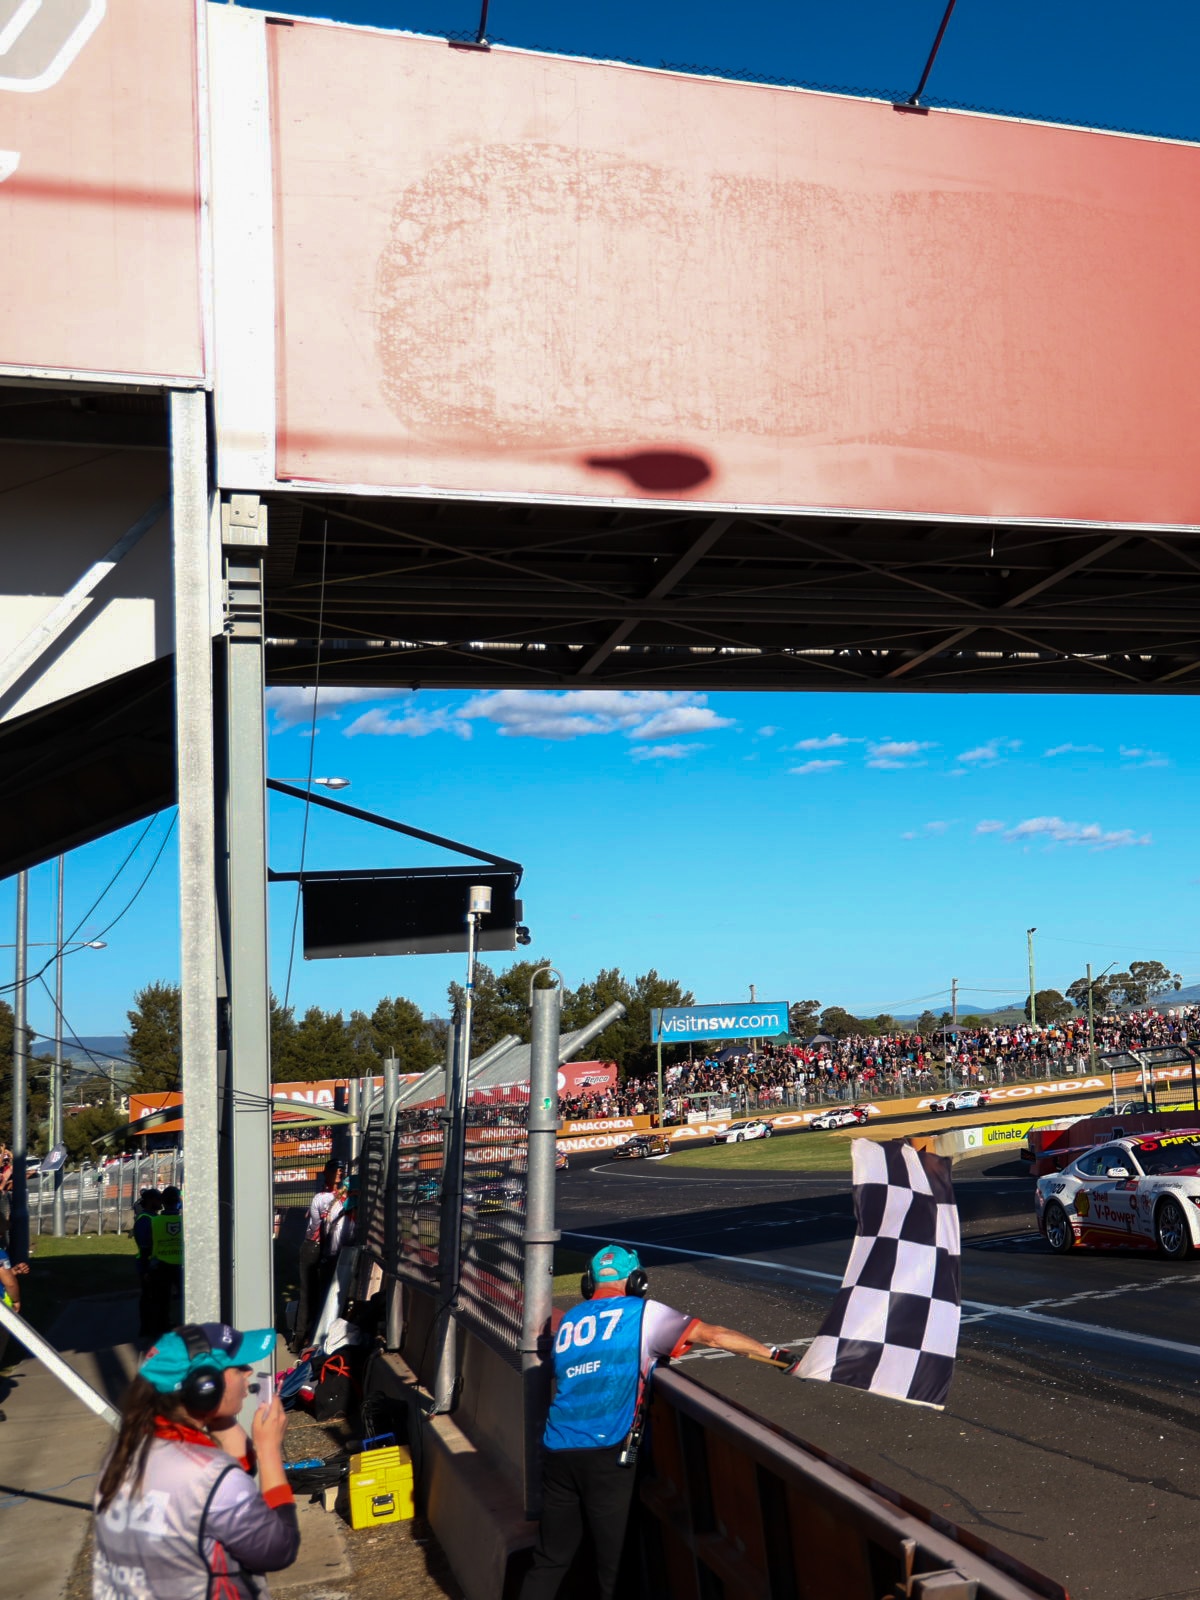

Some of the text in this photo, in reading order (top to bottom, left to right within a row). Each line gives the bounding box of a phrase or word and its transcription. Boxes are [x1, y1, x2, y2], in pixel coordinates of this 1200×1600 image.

[661, 1014, 779, 1033] visitnsw.com
[916, 1078, 1105, 1109] ACONDA
[569, 1119, 634, 1132] ANACONDA
[988, 1128, 1022, 1141] ultimate
[1092, 1190, 1109, 1203] Shell
[1094, 1203, 1136, 1225] V-Power
[555, 1308, 624, 1354] 007
[566, 1359, 602, 1379] CHIEF
